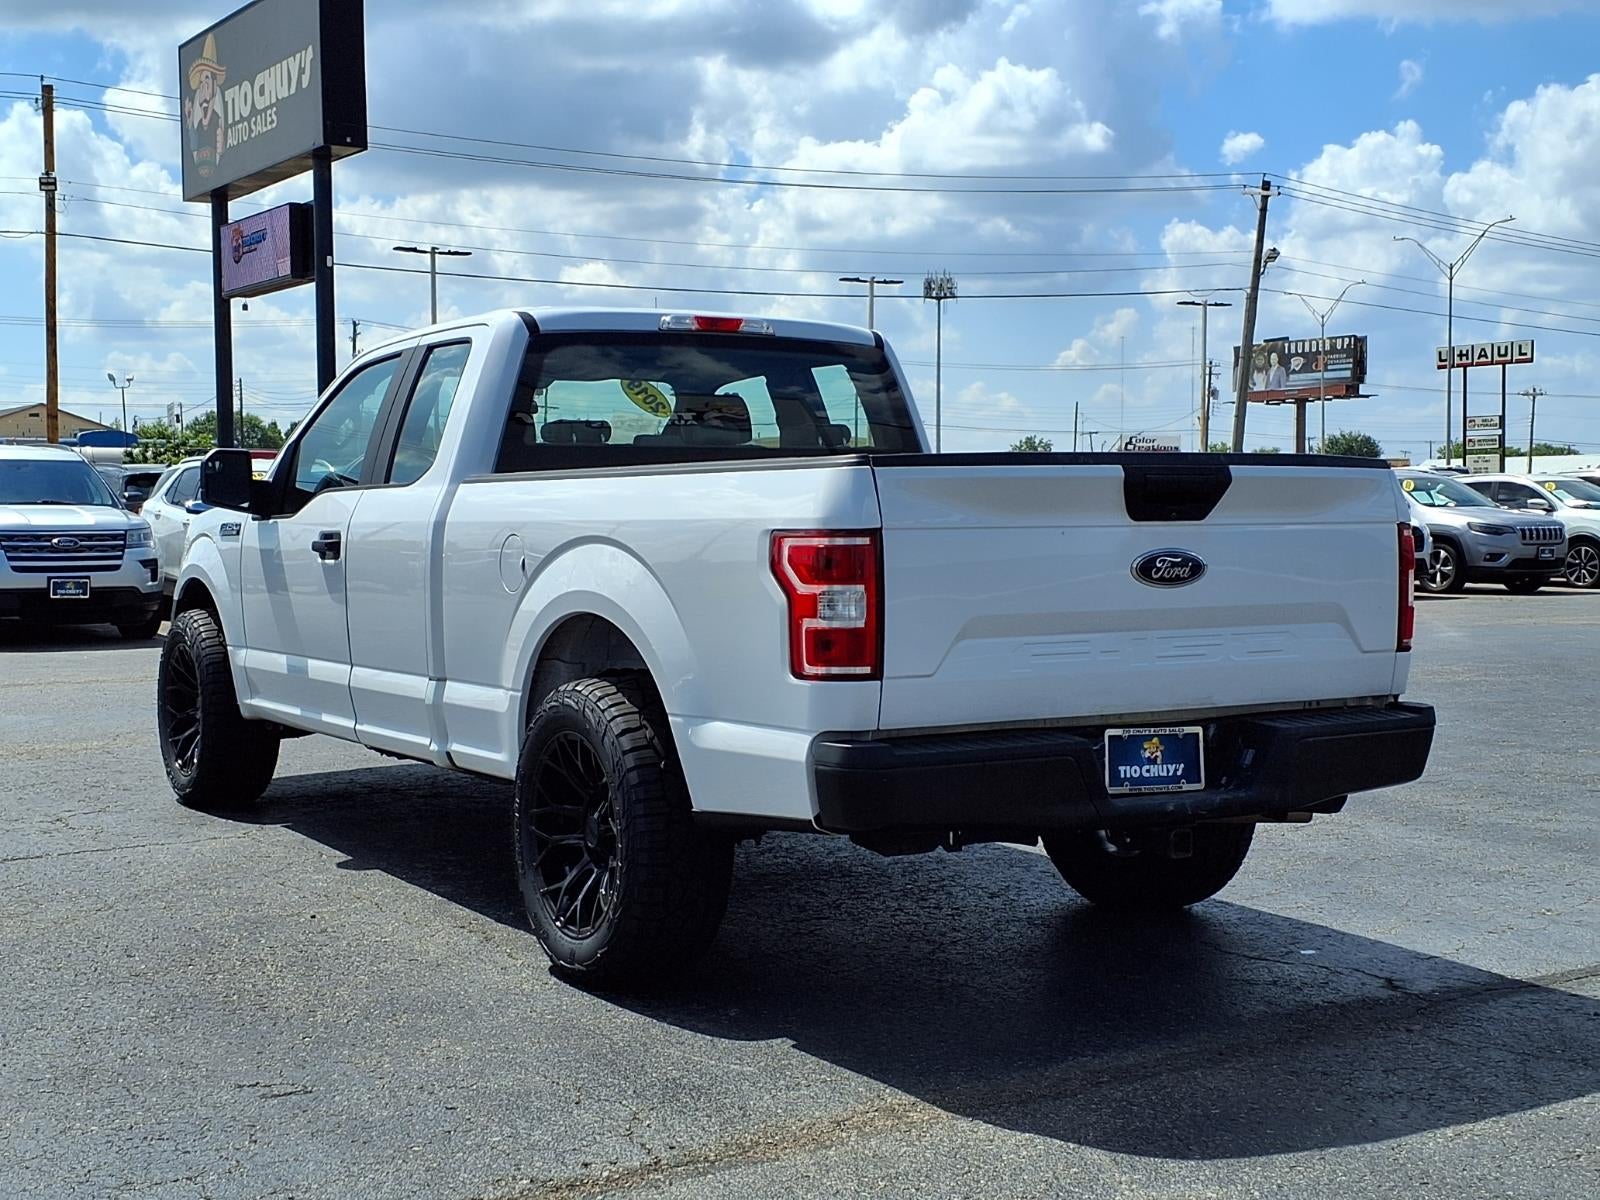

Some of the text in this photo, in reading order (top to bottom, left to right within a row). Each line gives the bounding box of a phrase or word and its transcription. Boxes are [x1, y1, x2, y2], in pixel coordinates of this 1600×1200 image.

[225, 45, 313, 124] TIO CHUY'S
[226, 106, 278, 149] AUTO SALES
[1284, 336, 1355, 354] THUNDER UP!
[1124, 442, 1180, 451] Creations
[1128, 436, 1157, 444] Color
[1151, 556, 1193, 579] Ford
[1118, 763, 1185, 778] TIO CHUY'S
